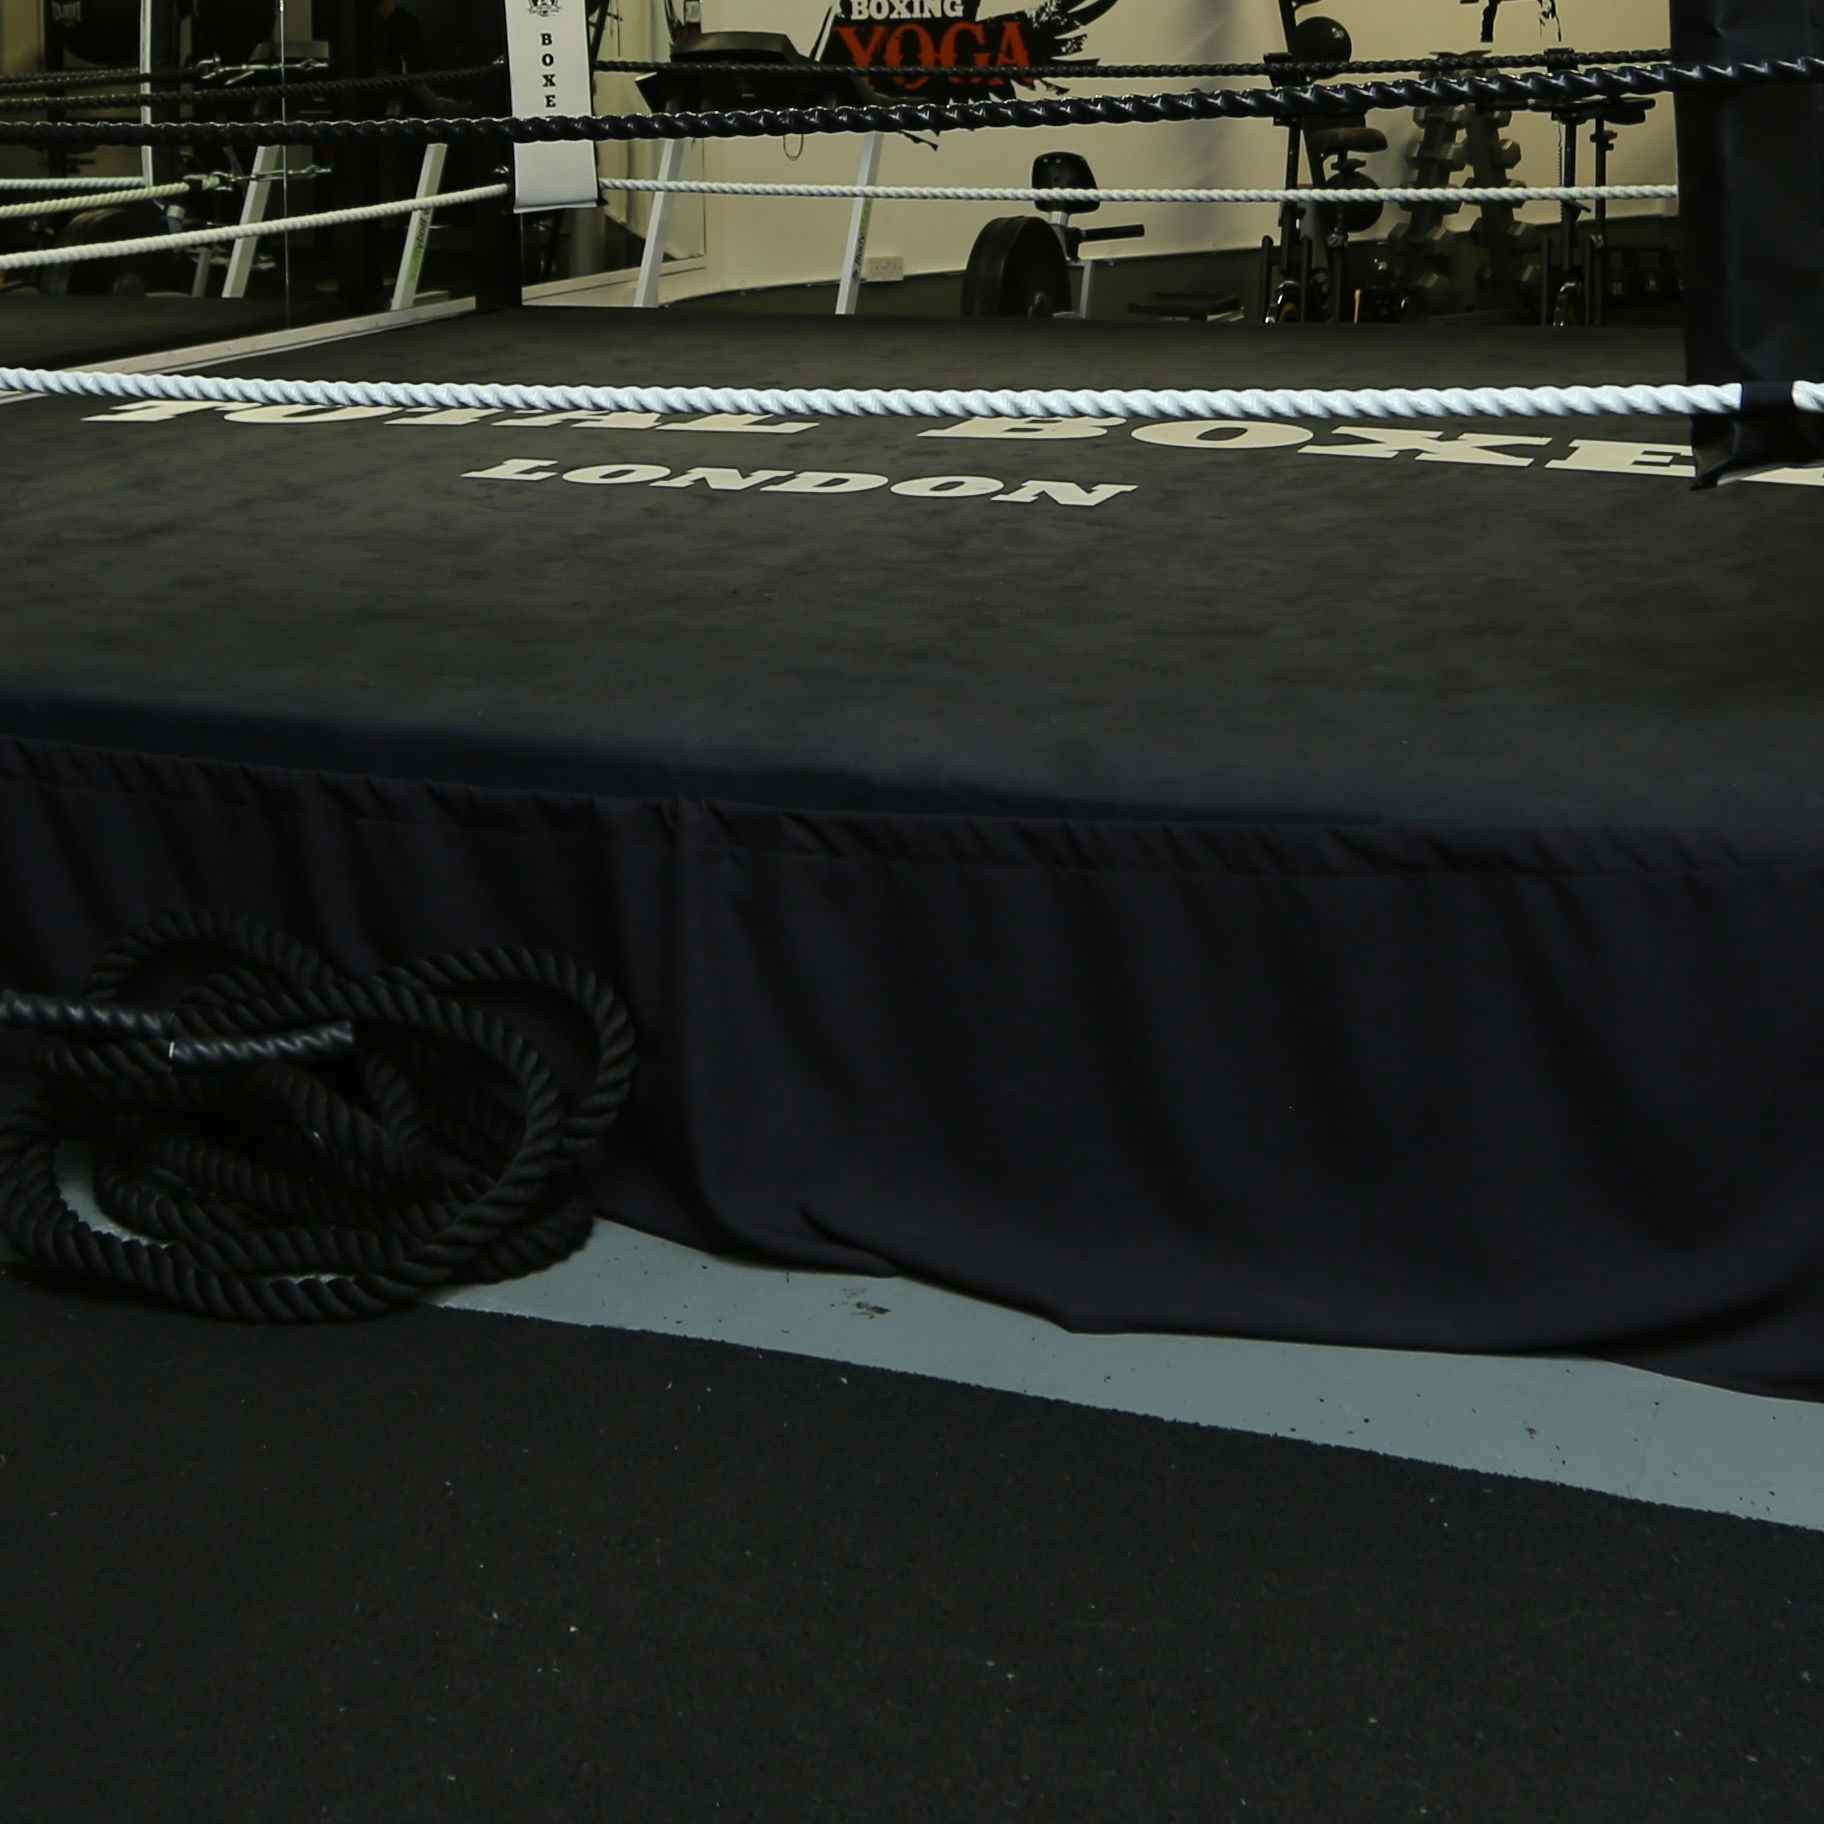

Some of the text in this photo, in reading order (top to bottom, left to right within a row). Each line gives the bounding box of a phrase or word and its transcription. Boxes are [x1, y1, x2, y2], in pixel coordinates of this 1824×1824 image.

[541, 33, 558, 117] BOXE
[833, 20, 1036, 90] YOGA
[459, 458, 1139, 507] LONDON
